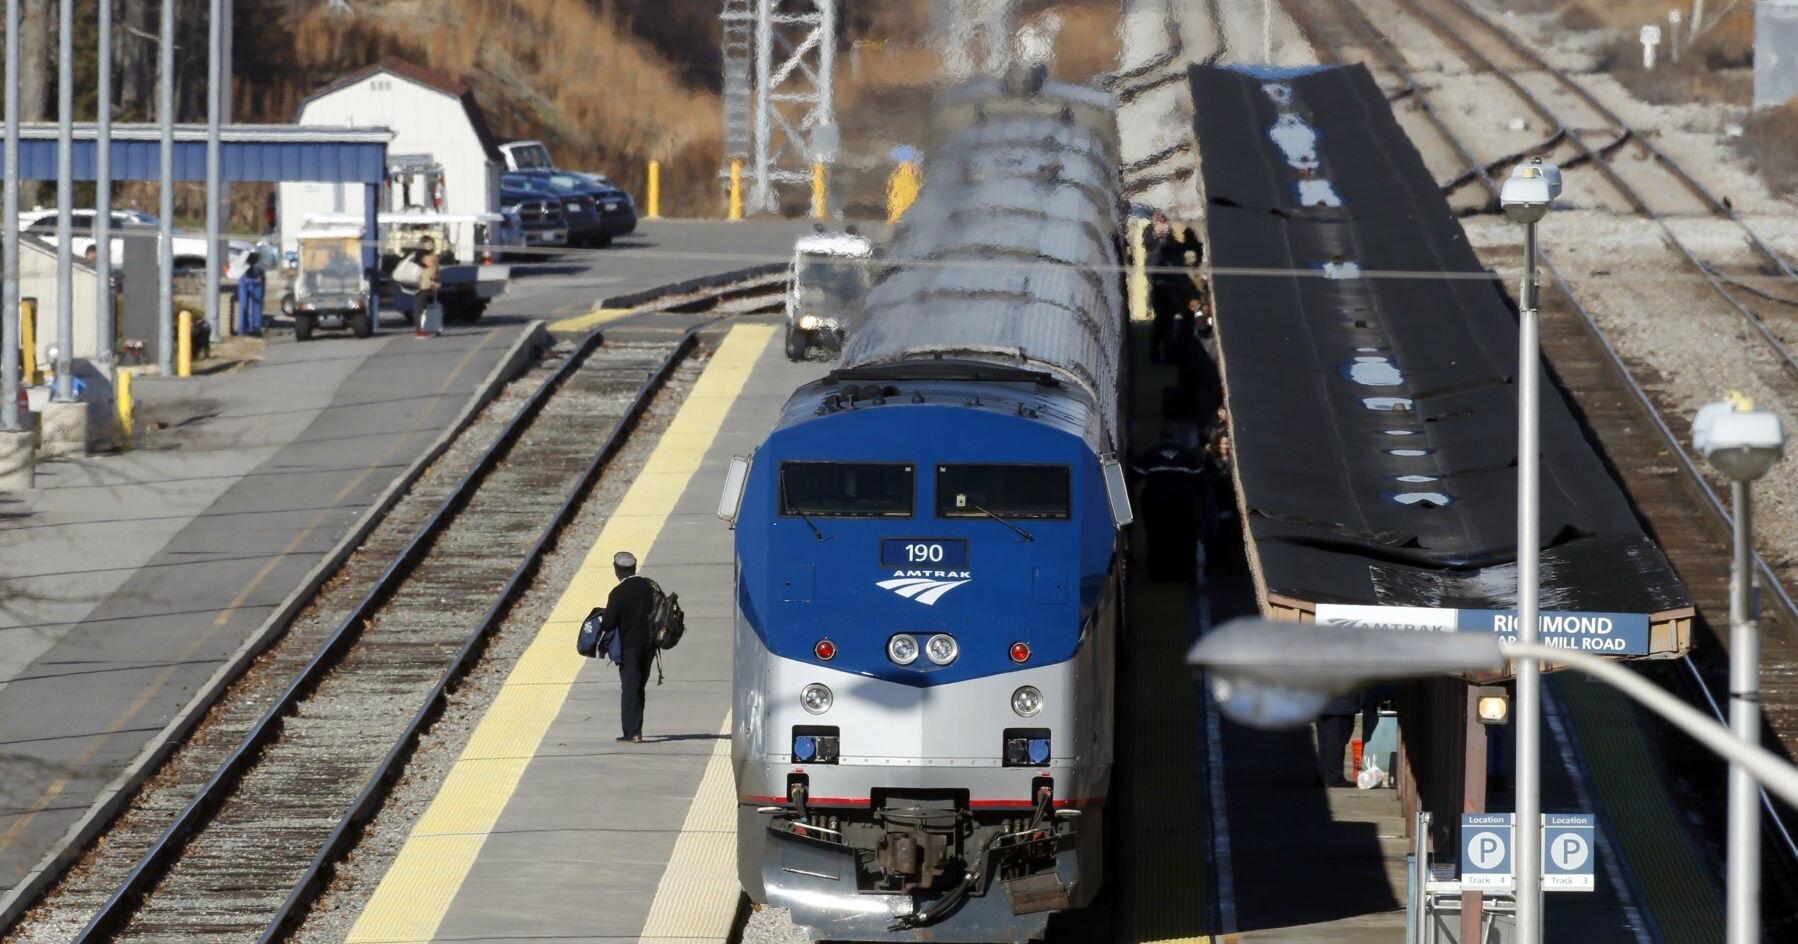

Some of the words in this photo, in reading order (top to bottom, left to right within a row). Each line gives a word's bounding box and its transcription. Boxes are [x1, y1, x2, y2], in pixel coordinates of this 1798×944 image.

[905, 544, 944, 562] 190
[893, 570, 971, 578] AMTRAK
[1494, 614, 1613, 634] RIMOND
[1545, 636, 1578, 649] MILL
[1582, 637, 1626, 651] ROAD
[1469, 816, 1504, 824] Location
[1552, 817, 1587, 825] Location
[1480, 838, 1498, 864] P
[1563, 839, 1581, 865] P
[1469, 876, 1490, 884] Track
[1552, 877, 1573, 885] Track
[1583, 877, 1588, 885] 3
